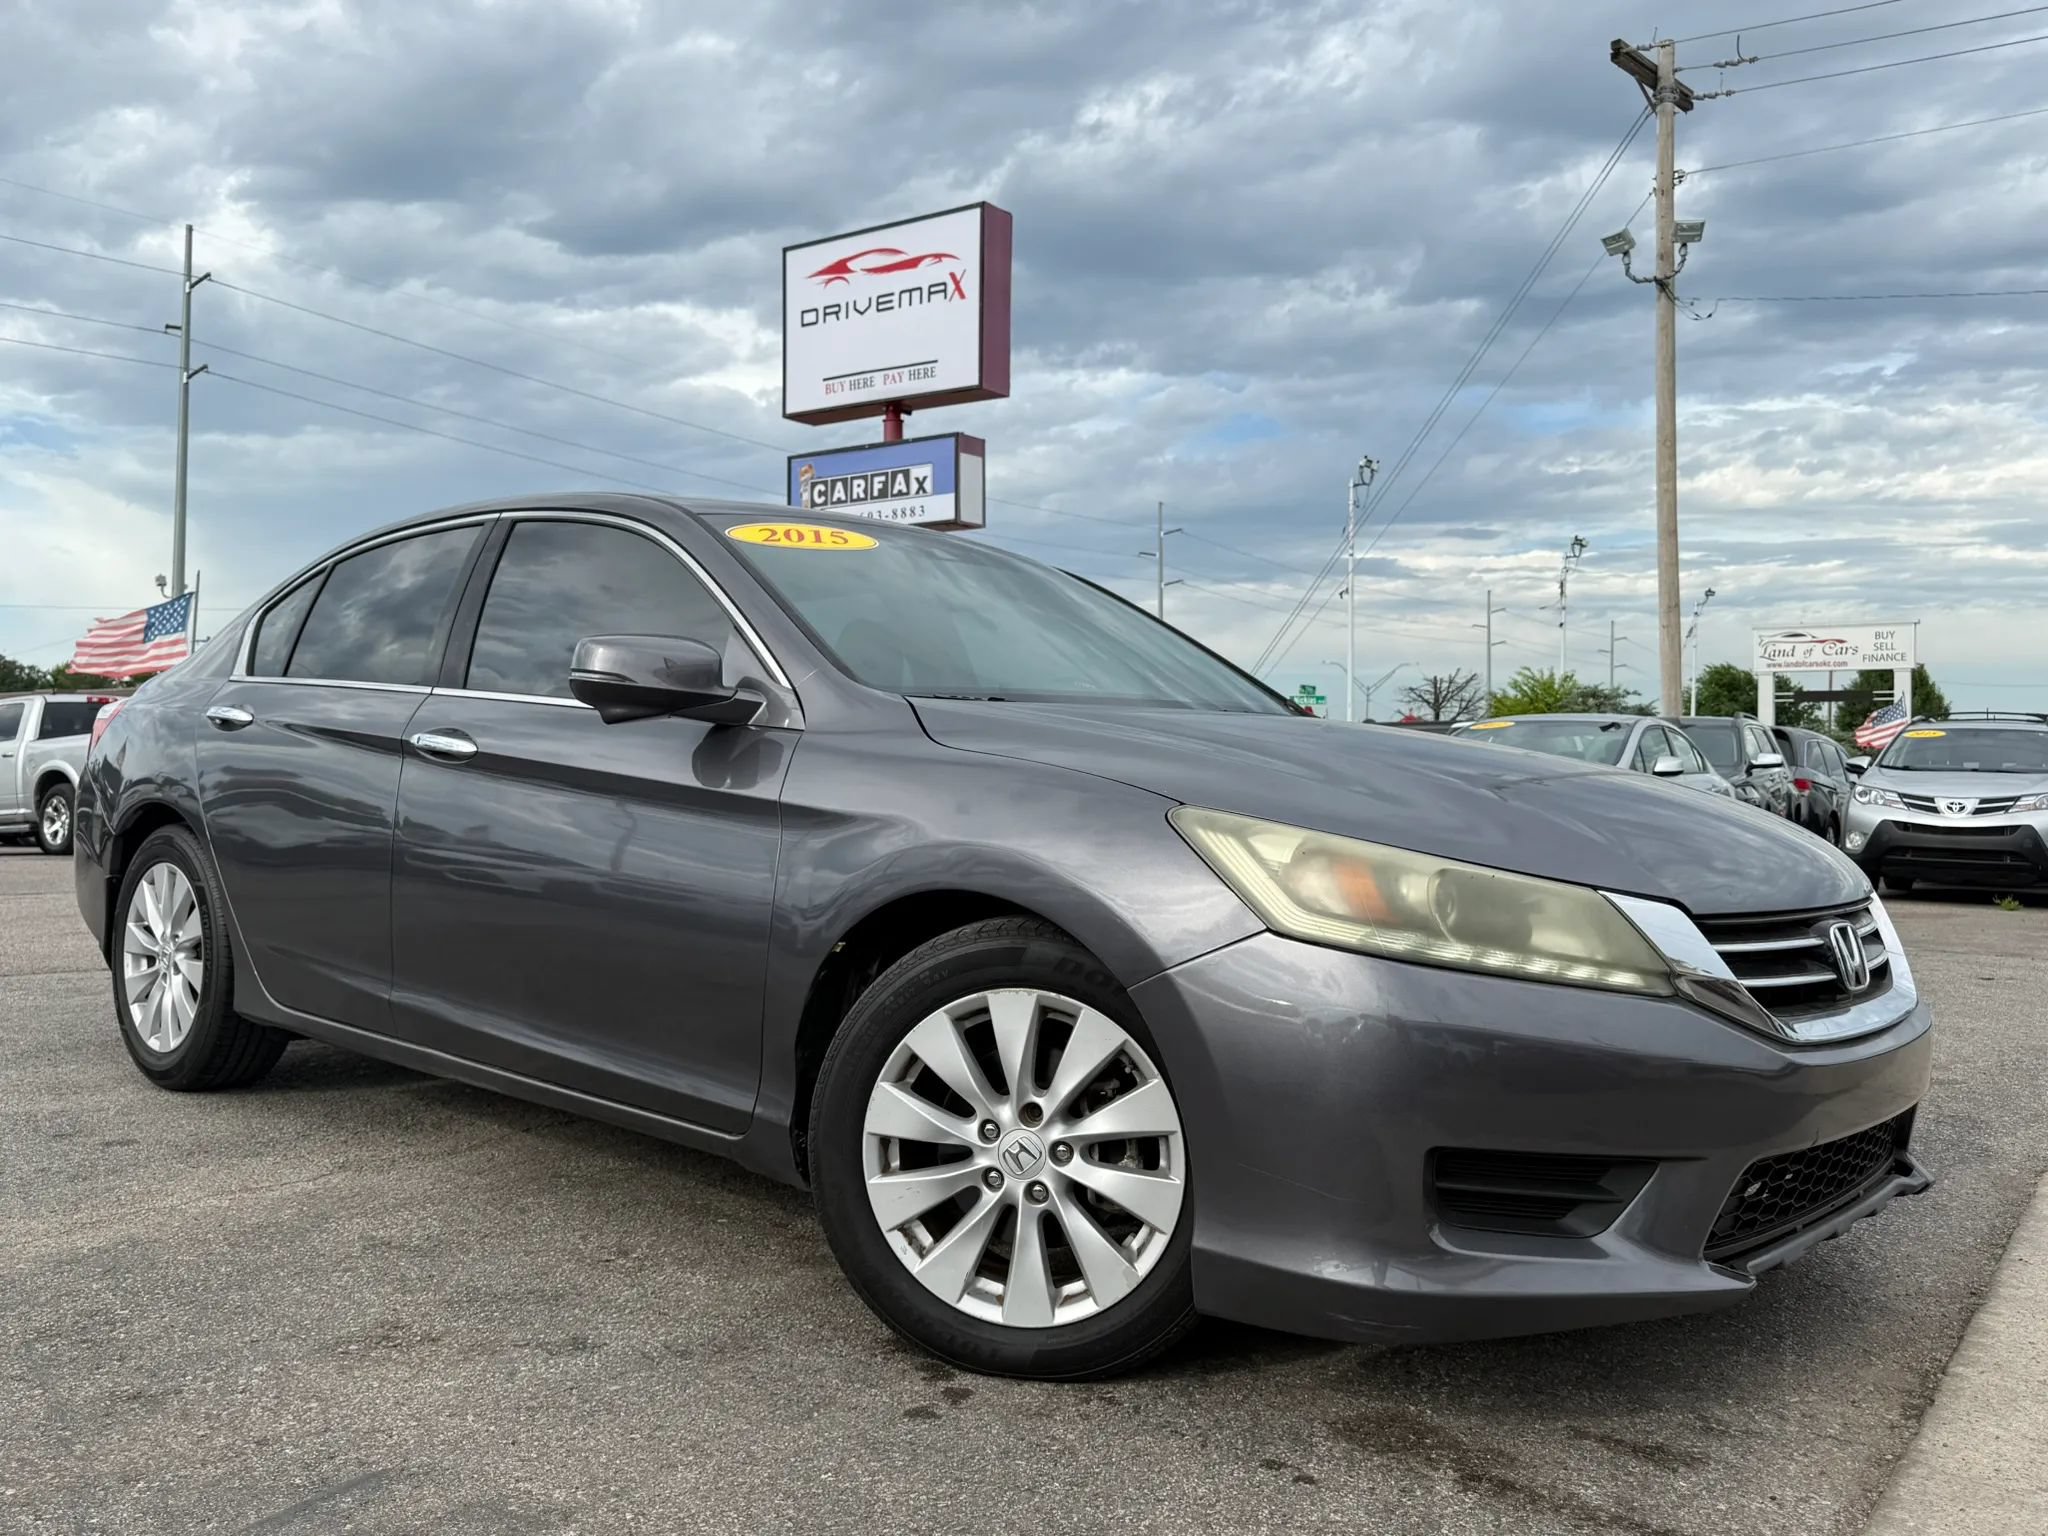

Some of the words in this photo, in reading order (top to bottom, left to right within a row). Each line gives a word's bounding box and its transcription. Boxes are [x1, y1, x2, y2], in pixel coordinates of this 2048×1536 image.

[801, 269, 966, 328] DRIVEMAX
[824, 380, 846, 395] BUY
[848, 376, 876, 392] HERE
[883, 371, 905, 386] PAY
[908, 366, 937, 381] HERE
[812, 470, 930, 505] CARFAX
[758, 528, 849, 545] 2015
[1874, 631, 1896, 640] BUY
[1759, 643, 1796, 661] Land
[1802, 645, 1816, 658] of
[1822, 641, 1859, 656] Cars
[1873, 642, 1896, 651] SELL
[1862, 652, 1907, 663] FINANCE
